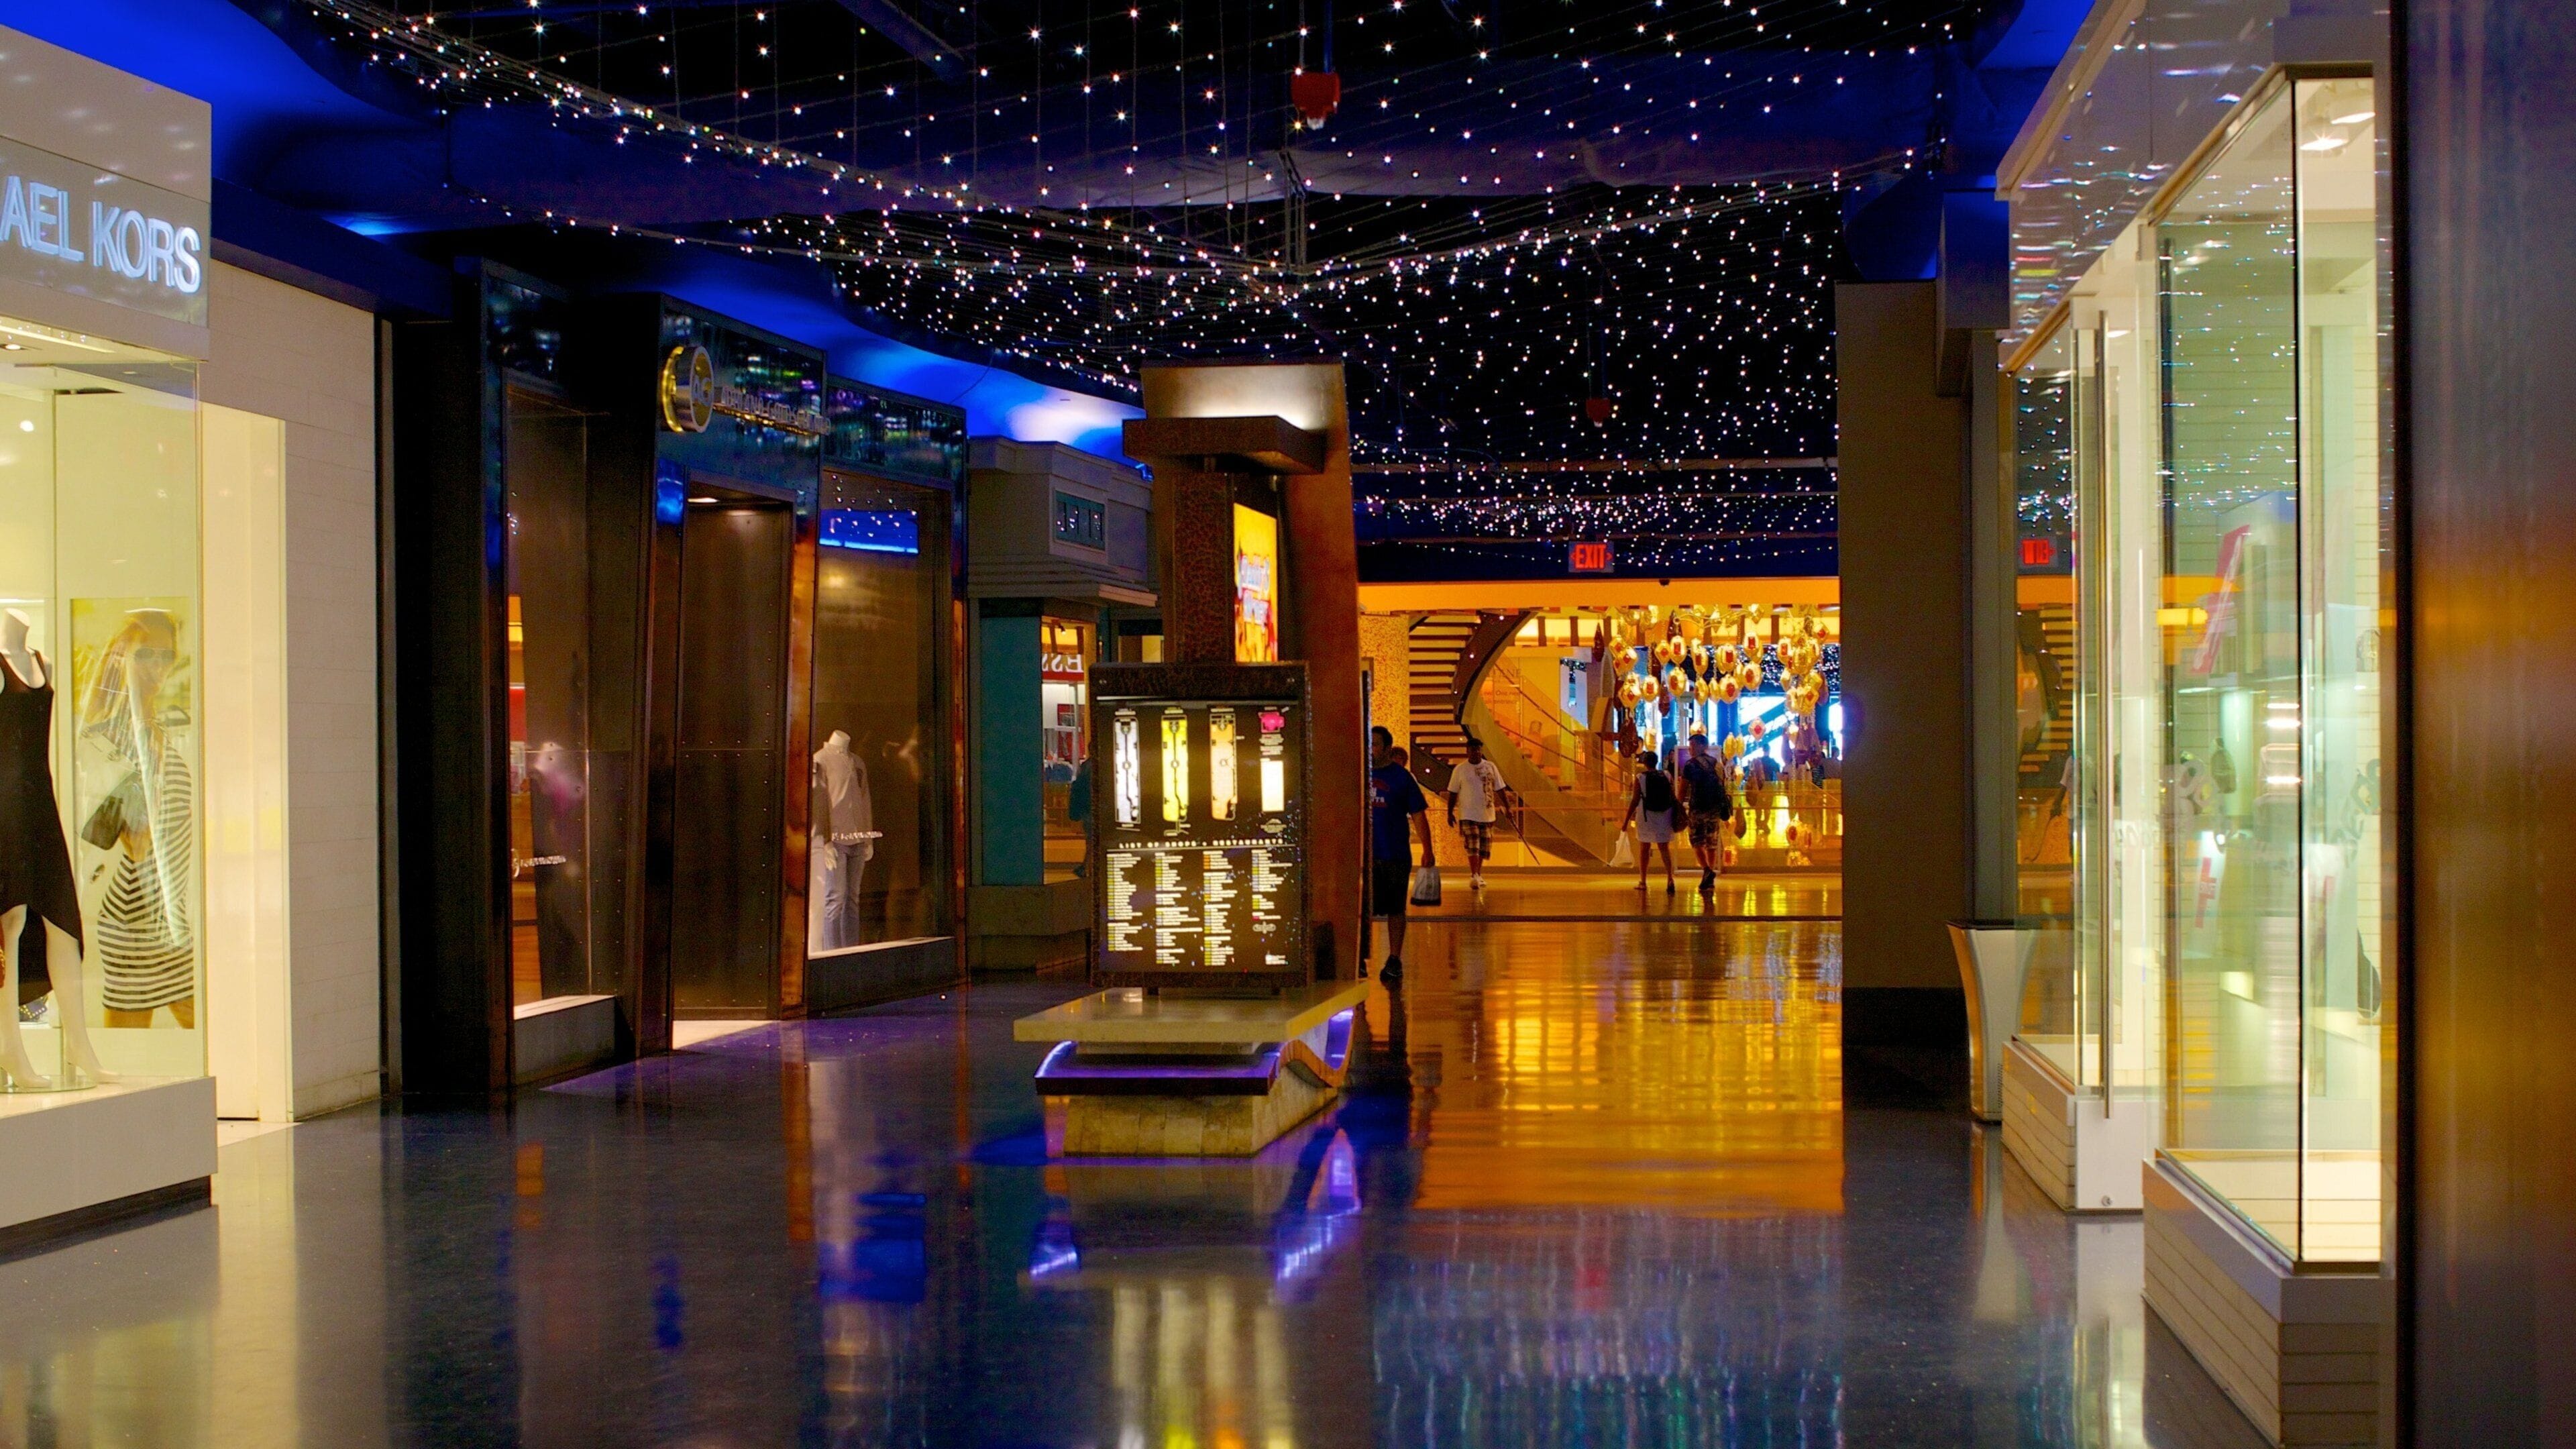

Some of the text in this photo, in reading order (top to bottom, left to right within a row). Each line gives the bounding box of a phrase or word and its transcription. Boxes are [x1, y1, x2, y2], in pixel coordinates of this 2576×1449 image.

[0, 174, 201, 294] AEL KORS
[1574, 543, 1607, 570] EXIT
